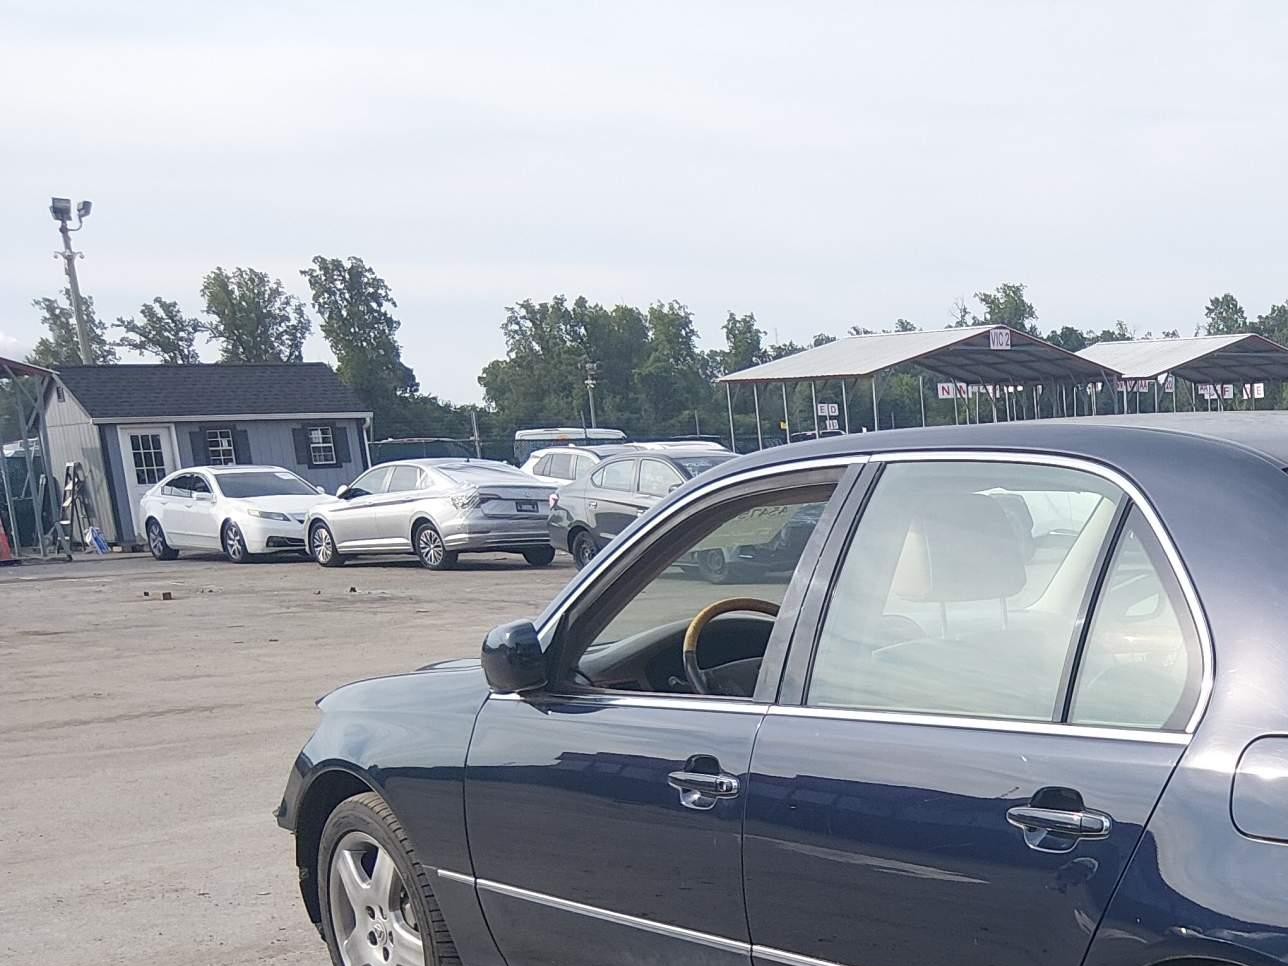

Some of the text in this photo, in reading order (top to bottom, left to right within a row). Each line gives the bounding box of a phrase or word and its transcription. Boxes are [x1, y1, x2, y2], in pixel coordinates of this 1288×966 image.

[991, 331, 1010, 348] VIC 2
[942, 386, 950, 396] N
